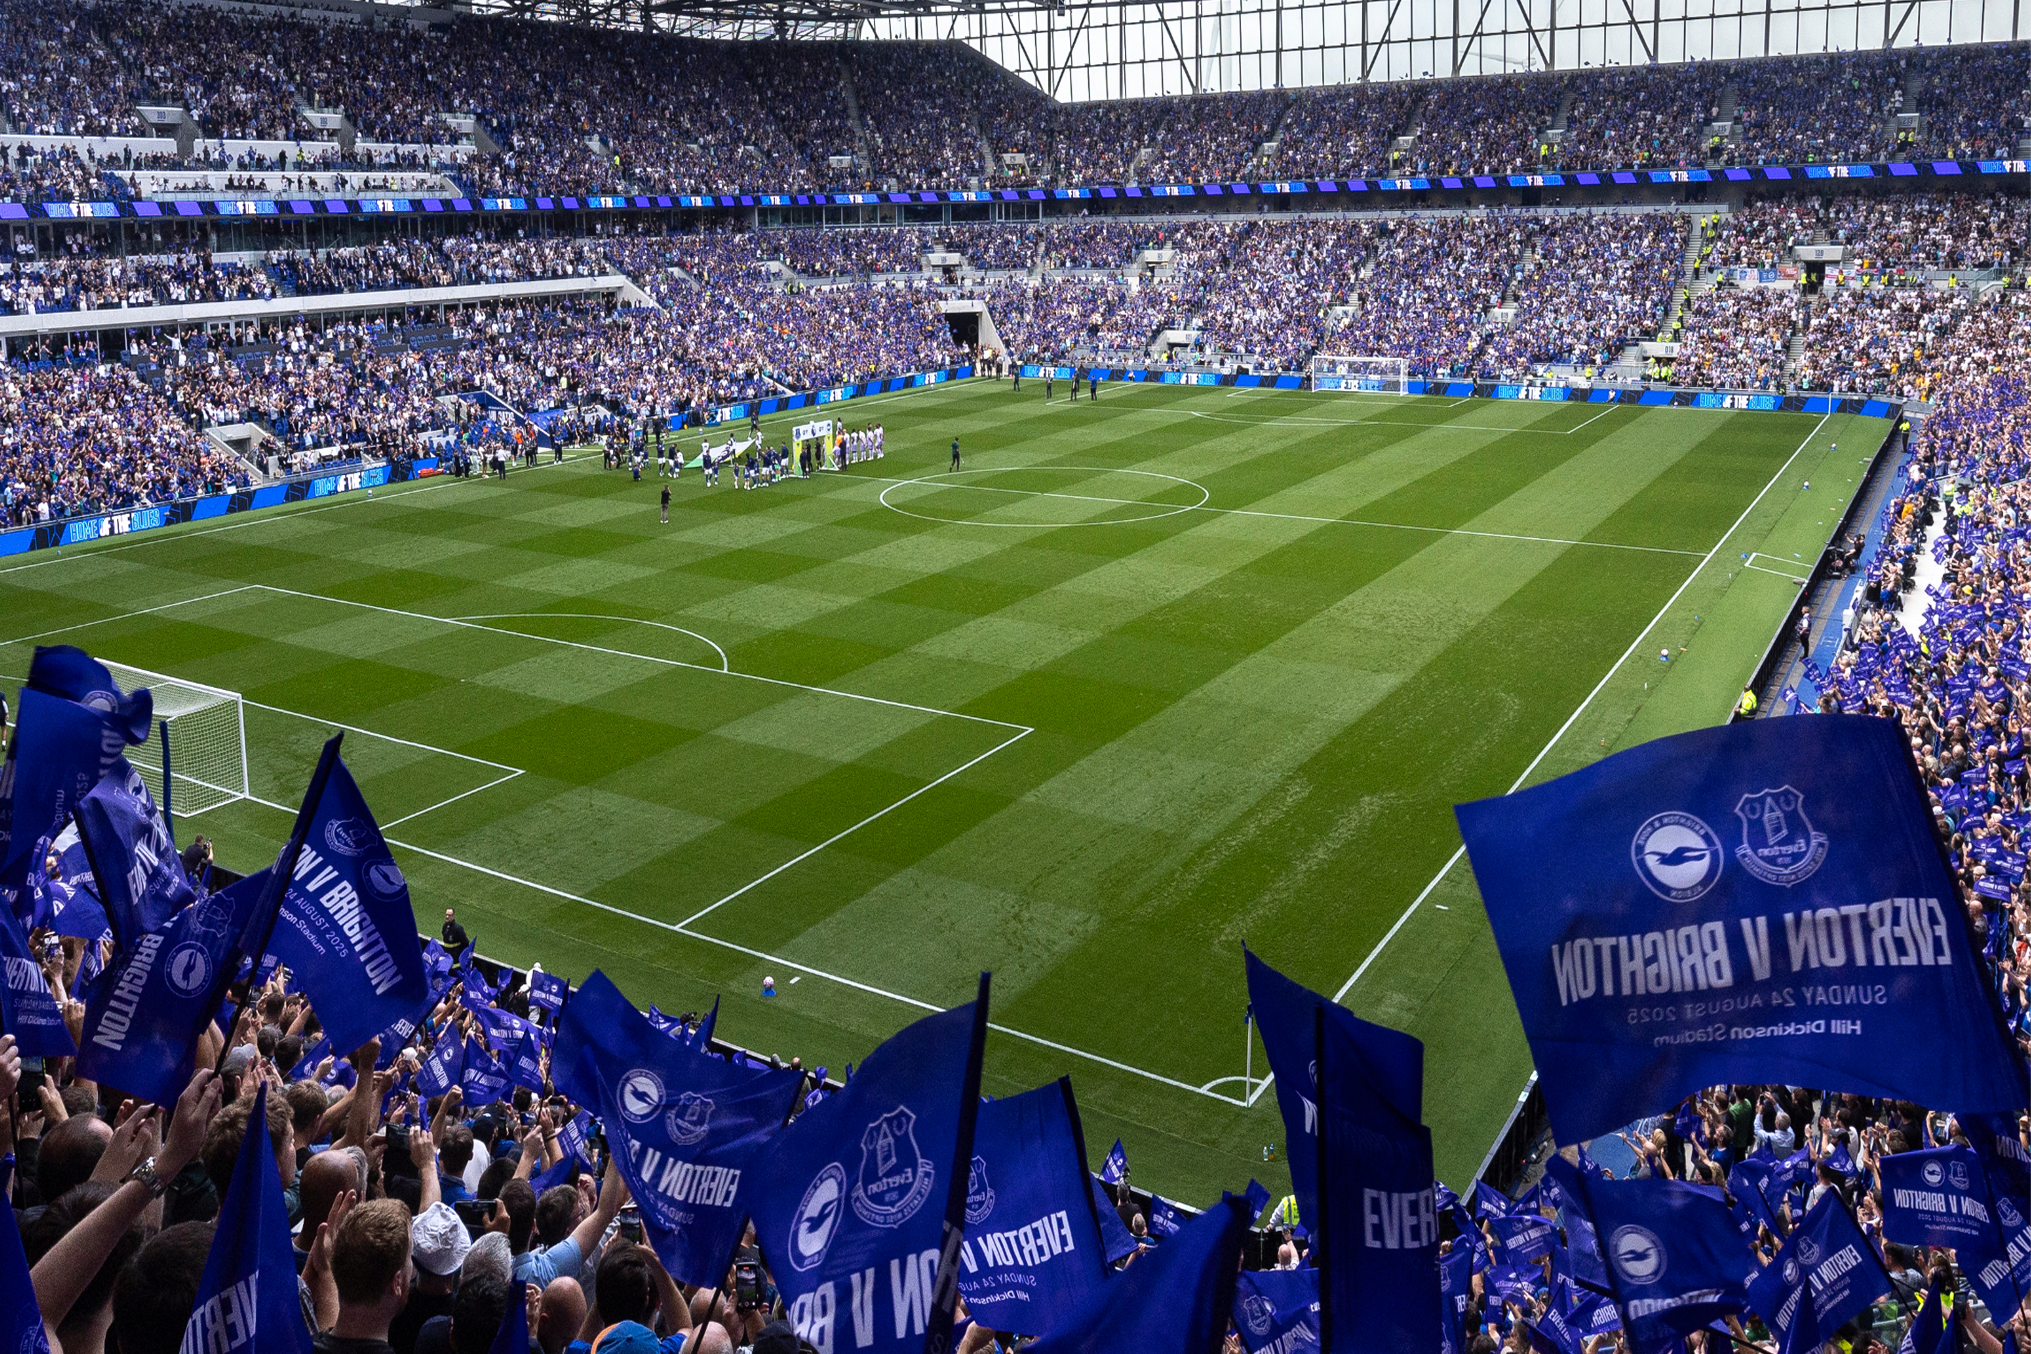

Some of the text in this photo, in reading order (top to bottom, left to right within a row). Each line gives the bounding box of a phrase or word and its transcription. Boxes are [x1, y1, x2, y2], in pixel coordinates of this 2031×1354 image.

[1499, 385, 1518, 399] HOME
[1528, 386, 1541, 400] THE
[1541, 387, 1564, 401] BLUES
[1700, 393, 1722, 408] HOME
[1734, 394, 1749, 409] THE
[1749, 395, 1775, 411] BLUES
[314, 477, 336, 497] HOME
[346, 472, 361, 490] THE
[70, 508, 160, 542] HOME OF THE BLUES
[336, 827, 356, 849] Everton
[284, 887, 350, 959] 24 AUGUST 2025
[296, 920, 327, 956] Stadium
[305, 865, 404, 996] V BRIGHTON
[92, 933, 165, 1052] BRIGHTON
[1362, 1187, 1437, 1250] EVER
